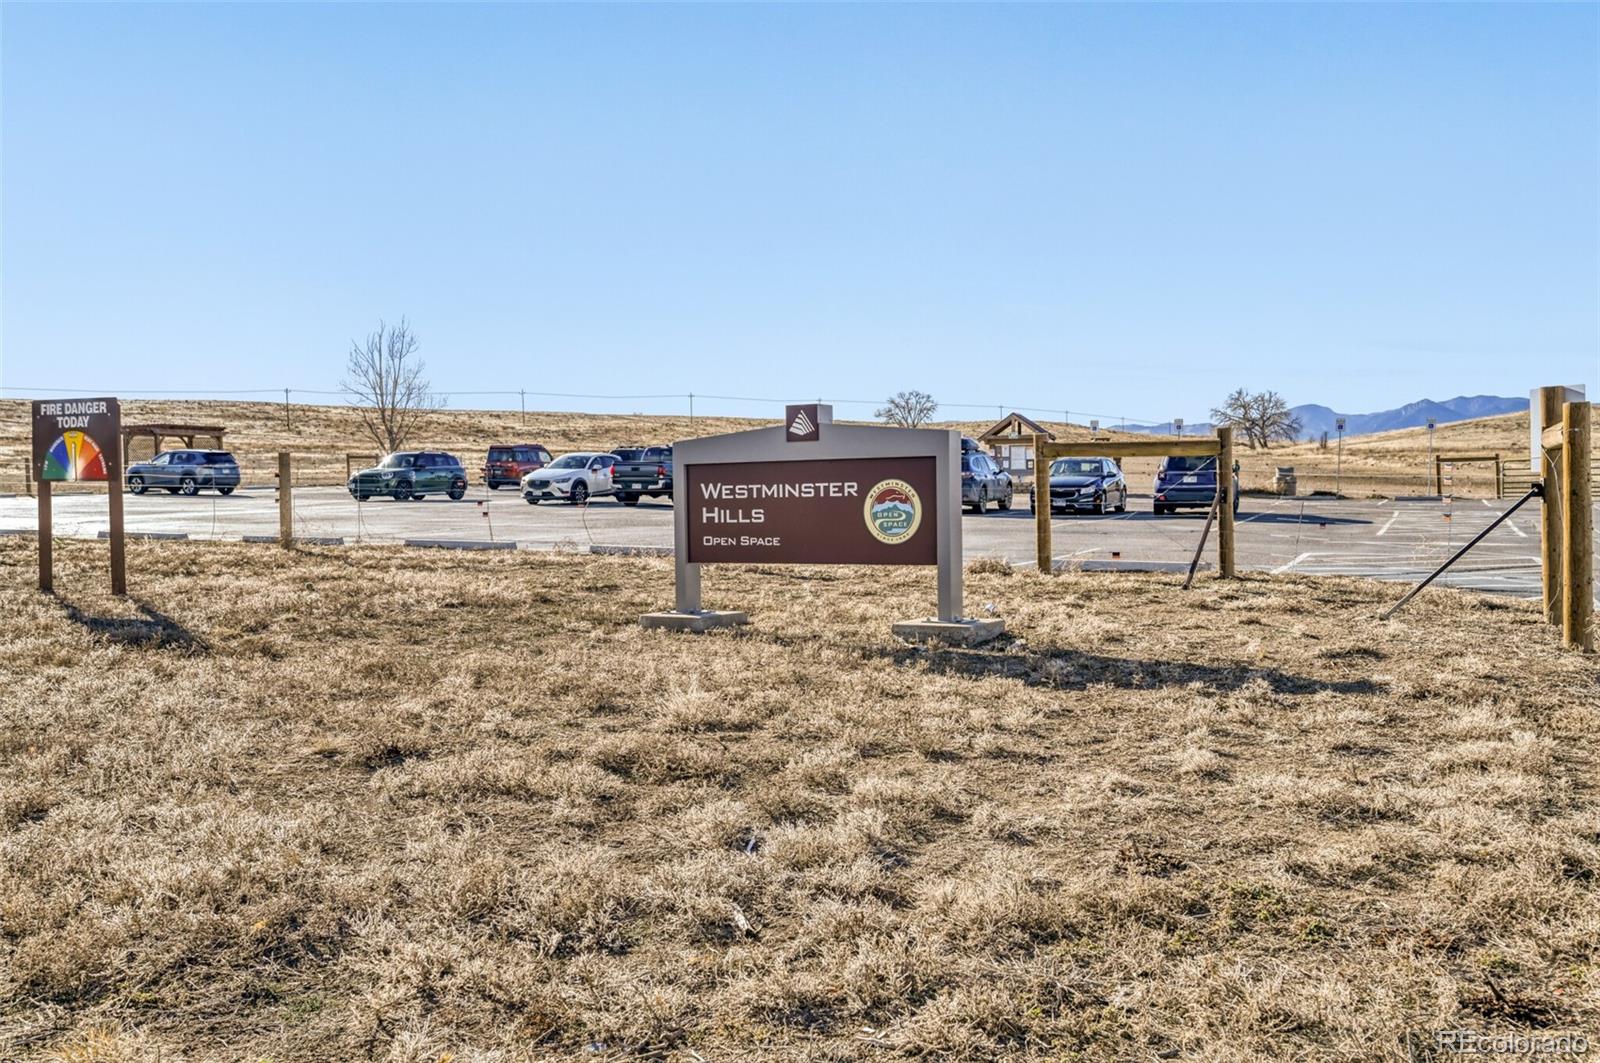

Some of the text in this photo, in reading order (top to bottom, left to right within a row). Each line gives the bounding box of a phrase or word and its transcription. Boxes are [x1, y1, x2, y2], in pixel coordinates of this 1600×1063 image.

[41, 401, 107, 415] FIRE DANGER
[56, 415, 90, 428] TODAY
[700, 482, 858, 499] WESTMINSTER
[702, 507, 765, 523] HILLS
[703, 536, 780, 546] OPEN SPACE
